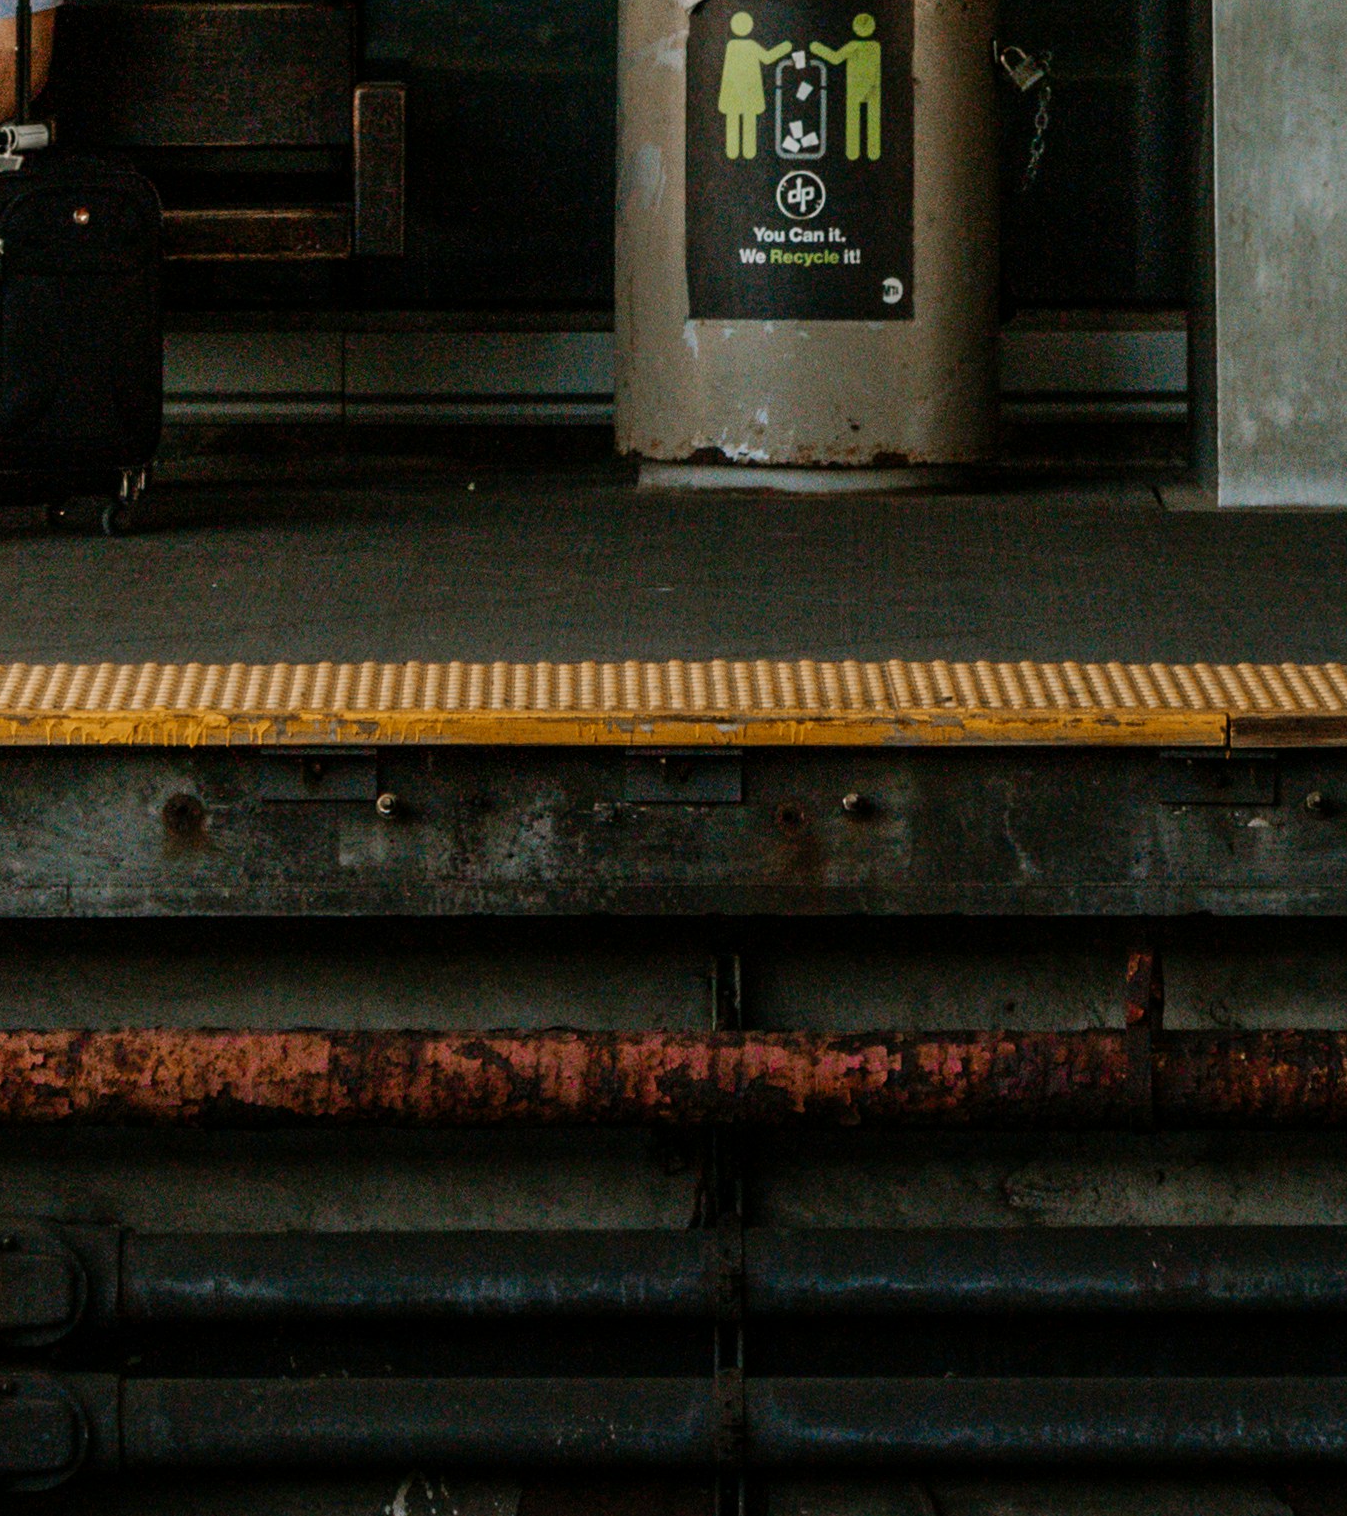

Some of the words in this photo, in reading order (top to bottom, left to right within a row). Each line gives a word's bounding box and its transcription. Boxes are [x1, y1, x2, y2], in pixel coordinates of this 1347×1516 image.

[752, 226, 785, 243] You
[788, 226, 825, 243] Can
[827, 226, 847, 243] it.
[739, 248, 767, 264] We
[769, 248, 840, 267] Recycle
[843, 248, 861, 264] it!
